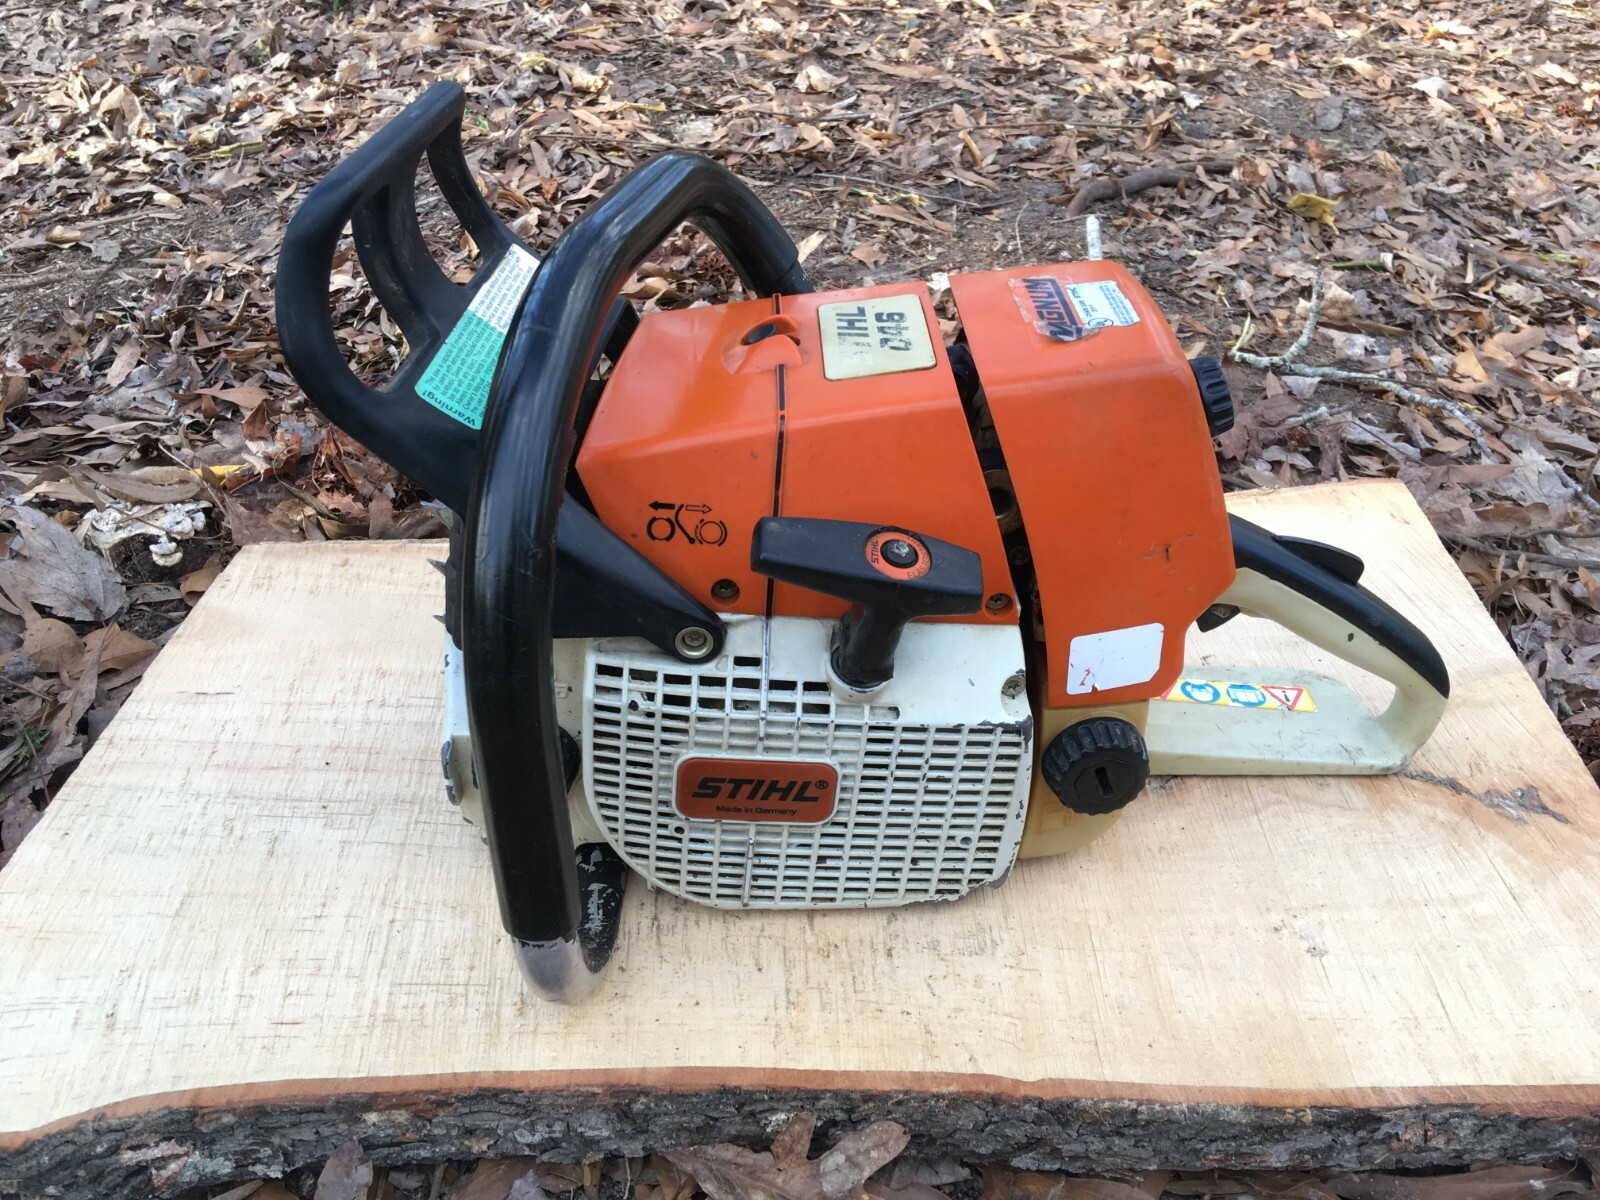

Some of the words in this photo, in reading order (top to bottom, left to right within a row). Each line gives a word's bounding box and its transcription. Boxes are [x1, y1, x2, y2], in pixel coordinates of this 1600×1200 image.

[422, 390, 476, 426] Warning!
[870, 540, 879, 564] STIHL
[716, 805, 742, 814] Made
[755, 807, 798, 816] Germany
